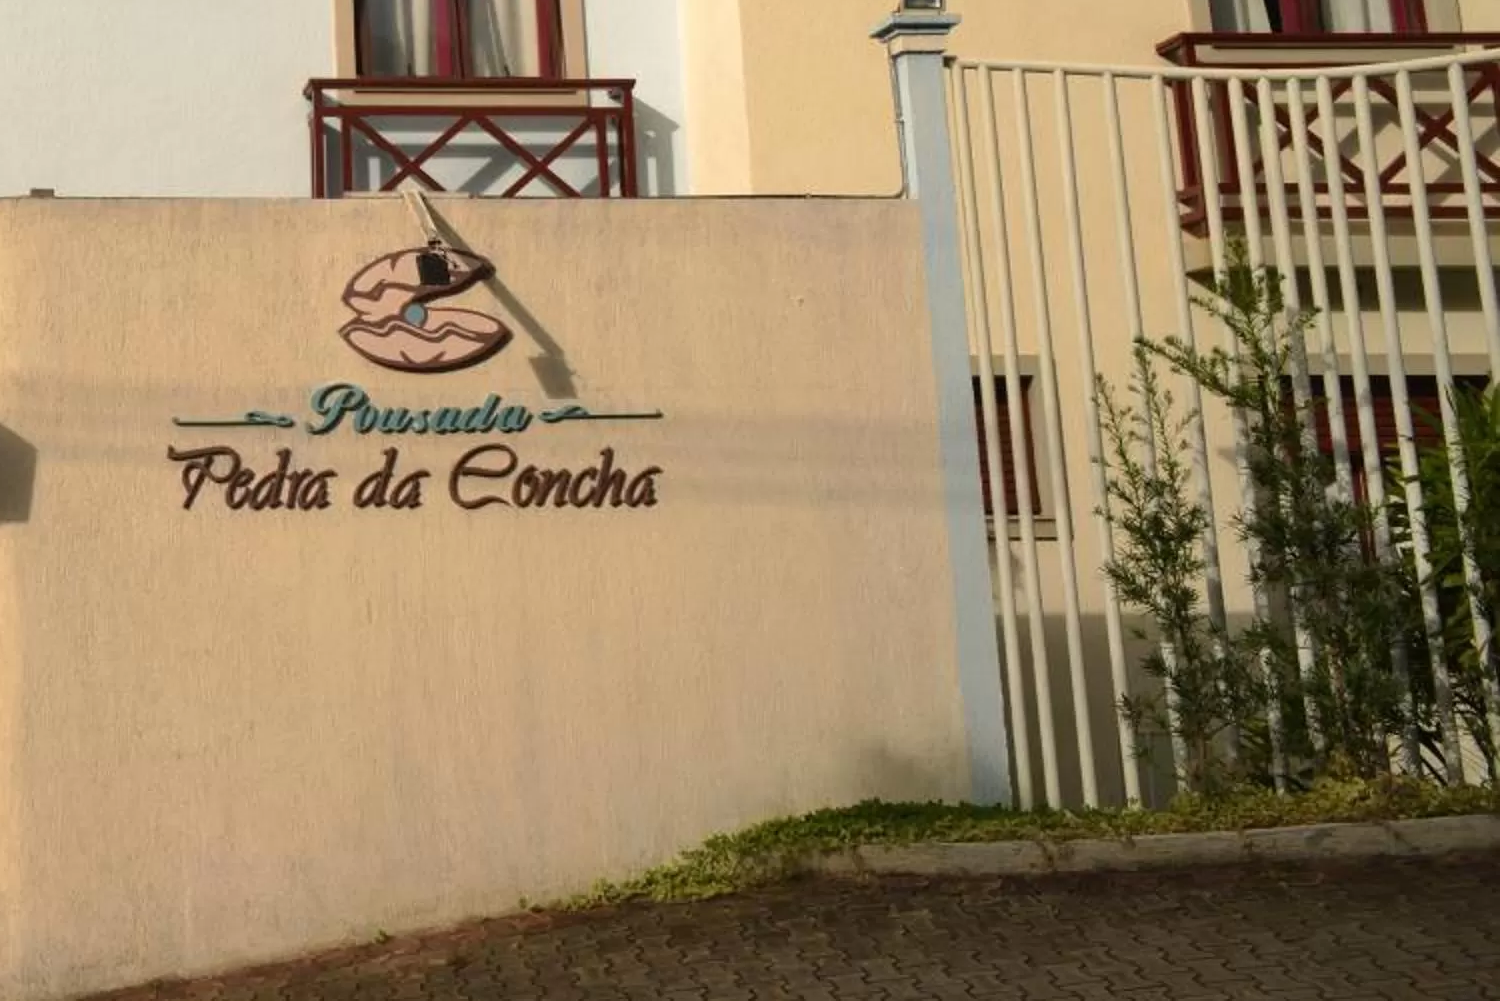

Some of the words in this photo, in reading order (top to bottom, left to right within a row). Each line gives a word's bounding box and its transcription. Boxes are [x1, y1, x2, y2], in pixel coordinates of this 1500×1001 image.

[305, 382, 532, 436] Pousada
[167, 445, 338, 510] Pedra
[352, 446, 431, 509] da
[449, 444, 664, 510] Concha
